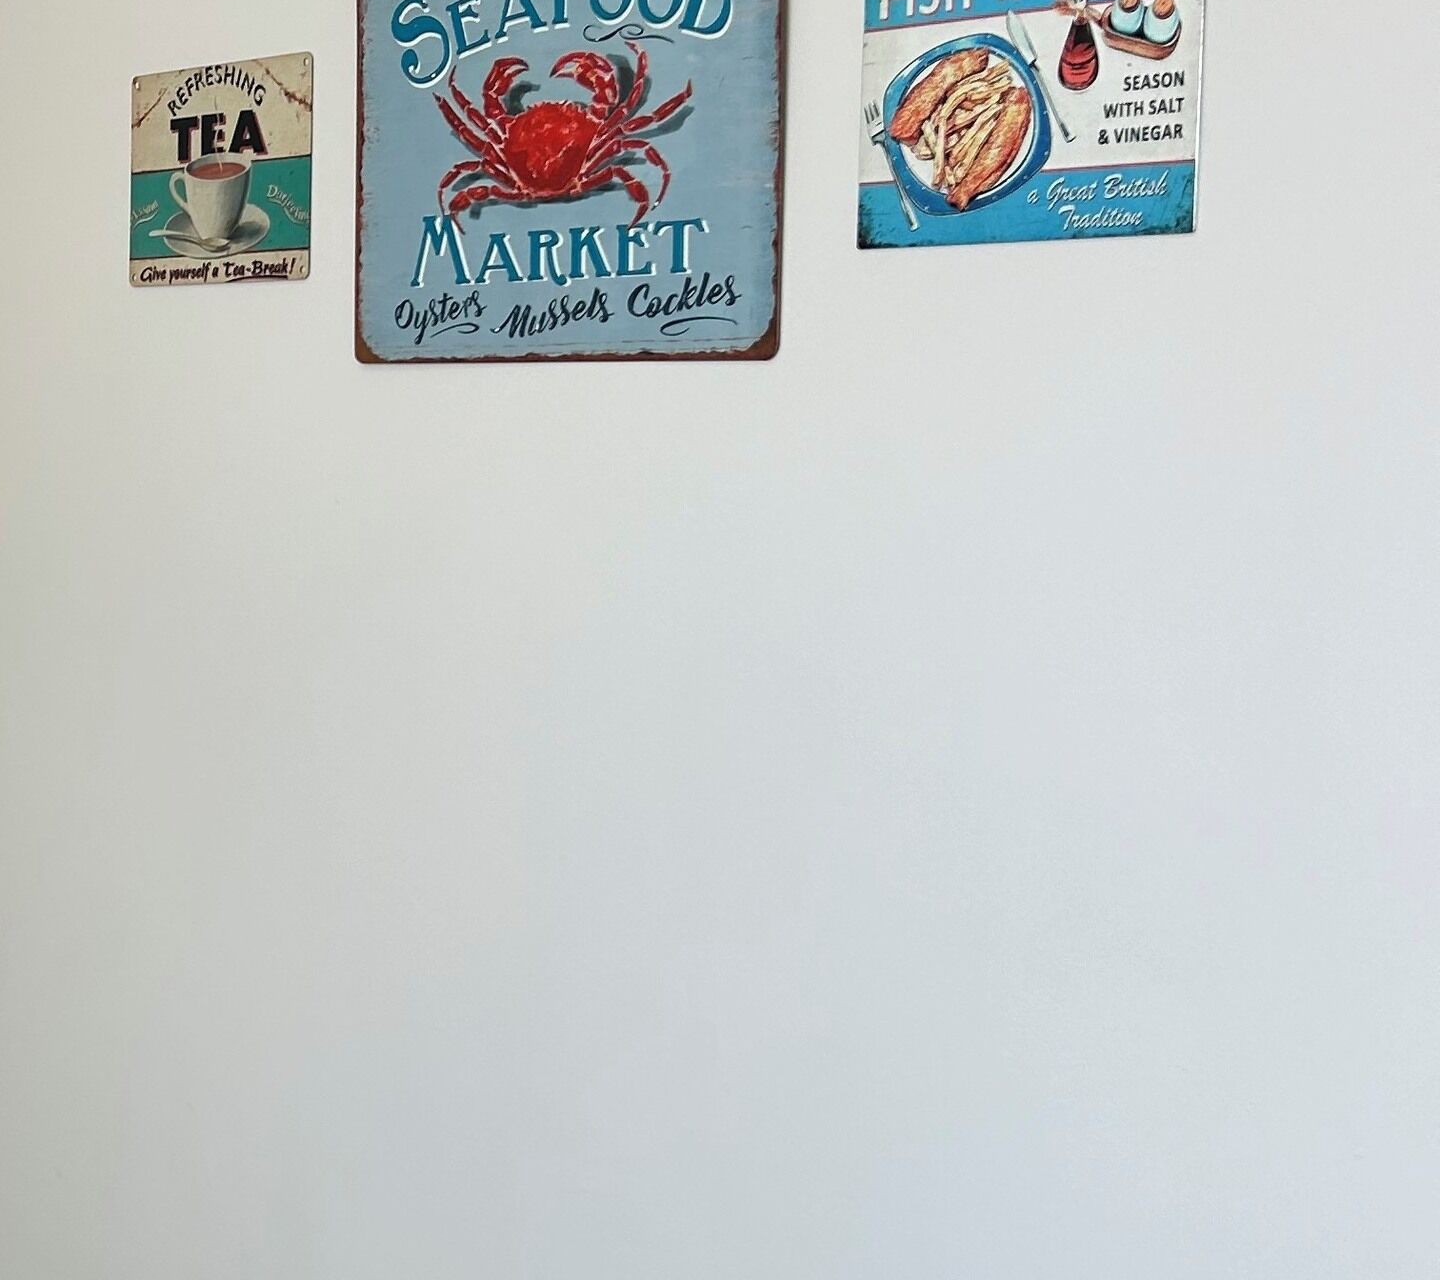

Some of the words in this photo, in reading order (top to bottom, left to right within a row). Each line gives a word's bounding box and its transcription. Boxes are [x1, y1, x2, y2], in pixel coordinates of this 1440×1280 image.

[167, 63, 267, 117] REFRESHING
[1122, 70, 1185, 92] SEASON
[1103, 102, 1144, 119] WITH
[1148, 96, 1185, 115] SALT
[170, 109, 268, 164] TEA
[1097, 128, 1109, 145] &
[1113, 124, 1183, 143] VINEGAR
[1026, 189, 1040, 205] a
[1046, 175, 1097, 211] Great
[1103, 168, 1169, 201] British
[1058, 203, 1144, 232] Tradition
[409, 215, 712, 290] MARKET
[140, 265, 167, 283] Give
[169, 261, 211, 285] yourself
[212, 267, 218, 278] a
[394, 288, 488, 346] Oysters
[490, 286, 616, 340] Mussels
[625, 271, 744, 320] Cockles
